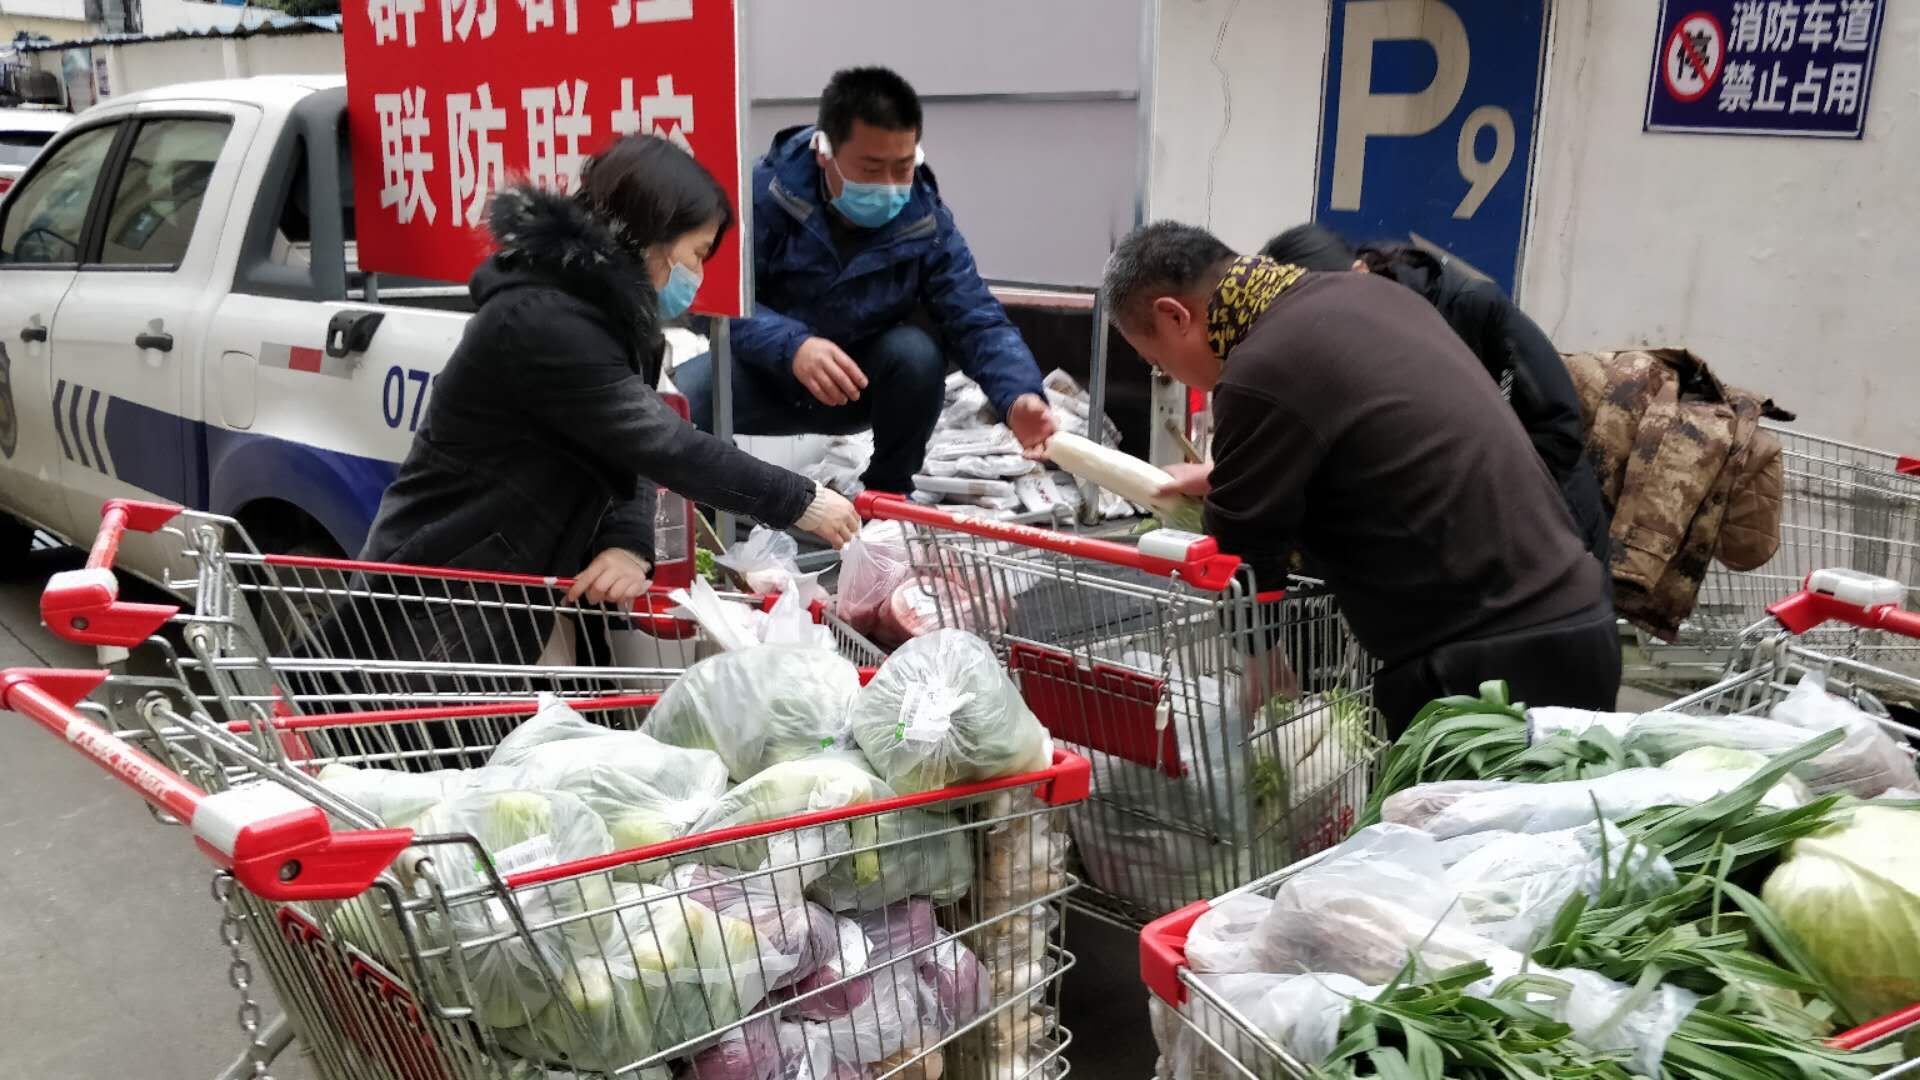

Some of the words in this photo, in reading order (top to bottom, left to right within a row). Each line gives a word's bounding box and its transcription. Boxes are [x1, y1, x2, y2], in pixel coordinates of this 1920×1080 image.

[1728, 0, 1875, 52] 消防车道
[1718, 60, 1864, 115] 禁止占用
[383, 365, 437, 432] 07
